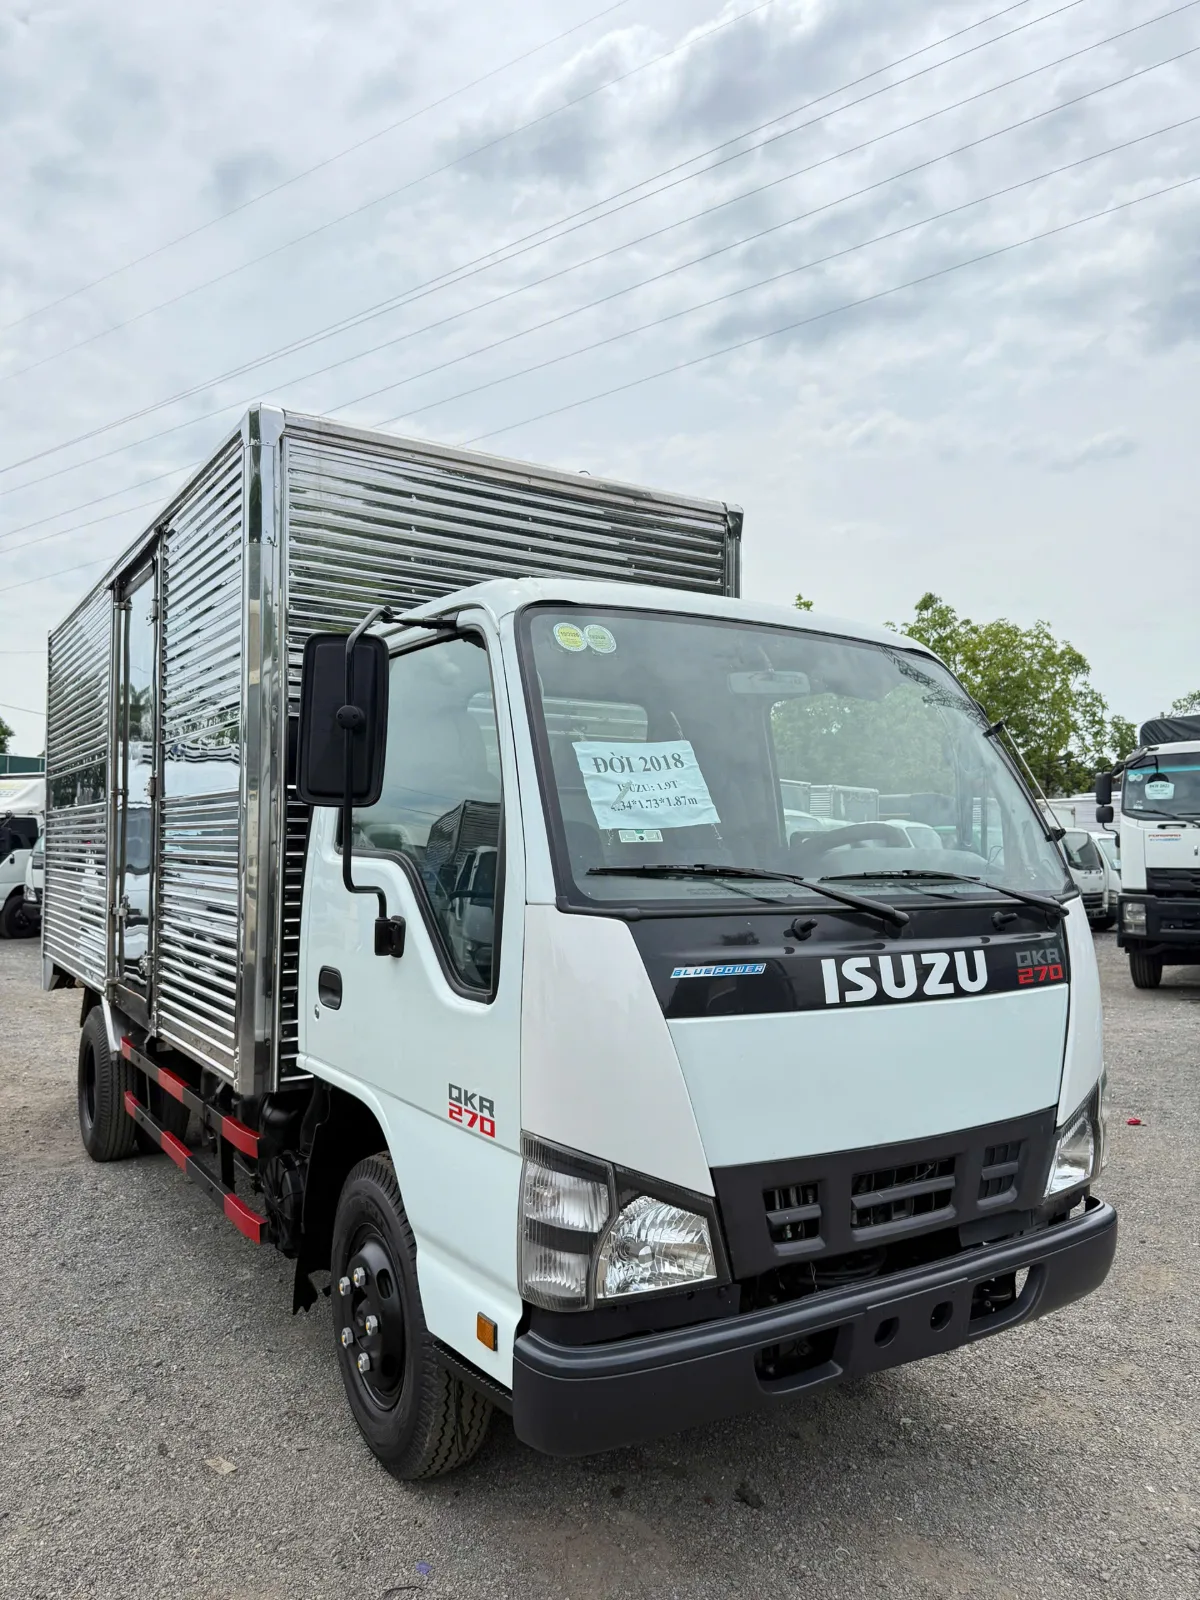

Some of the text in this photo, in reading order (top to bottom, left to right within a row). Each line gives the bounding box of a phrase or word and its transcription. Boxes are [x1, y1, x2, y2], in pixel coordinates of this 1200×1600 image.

[592, 752, 686, 773] ĐỜI 2018
[657, 780, 679, 792] 1.9T
[1015, 947, 1060, 967] QKR
[821, 949, 989, 1005] ISUZU
[1017, 963, 1064, 984] 270
[448, 1082, 495, 1119] QKR
[448, 1101, 496, 1139] 270
